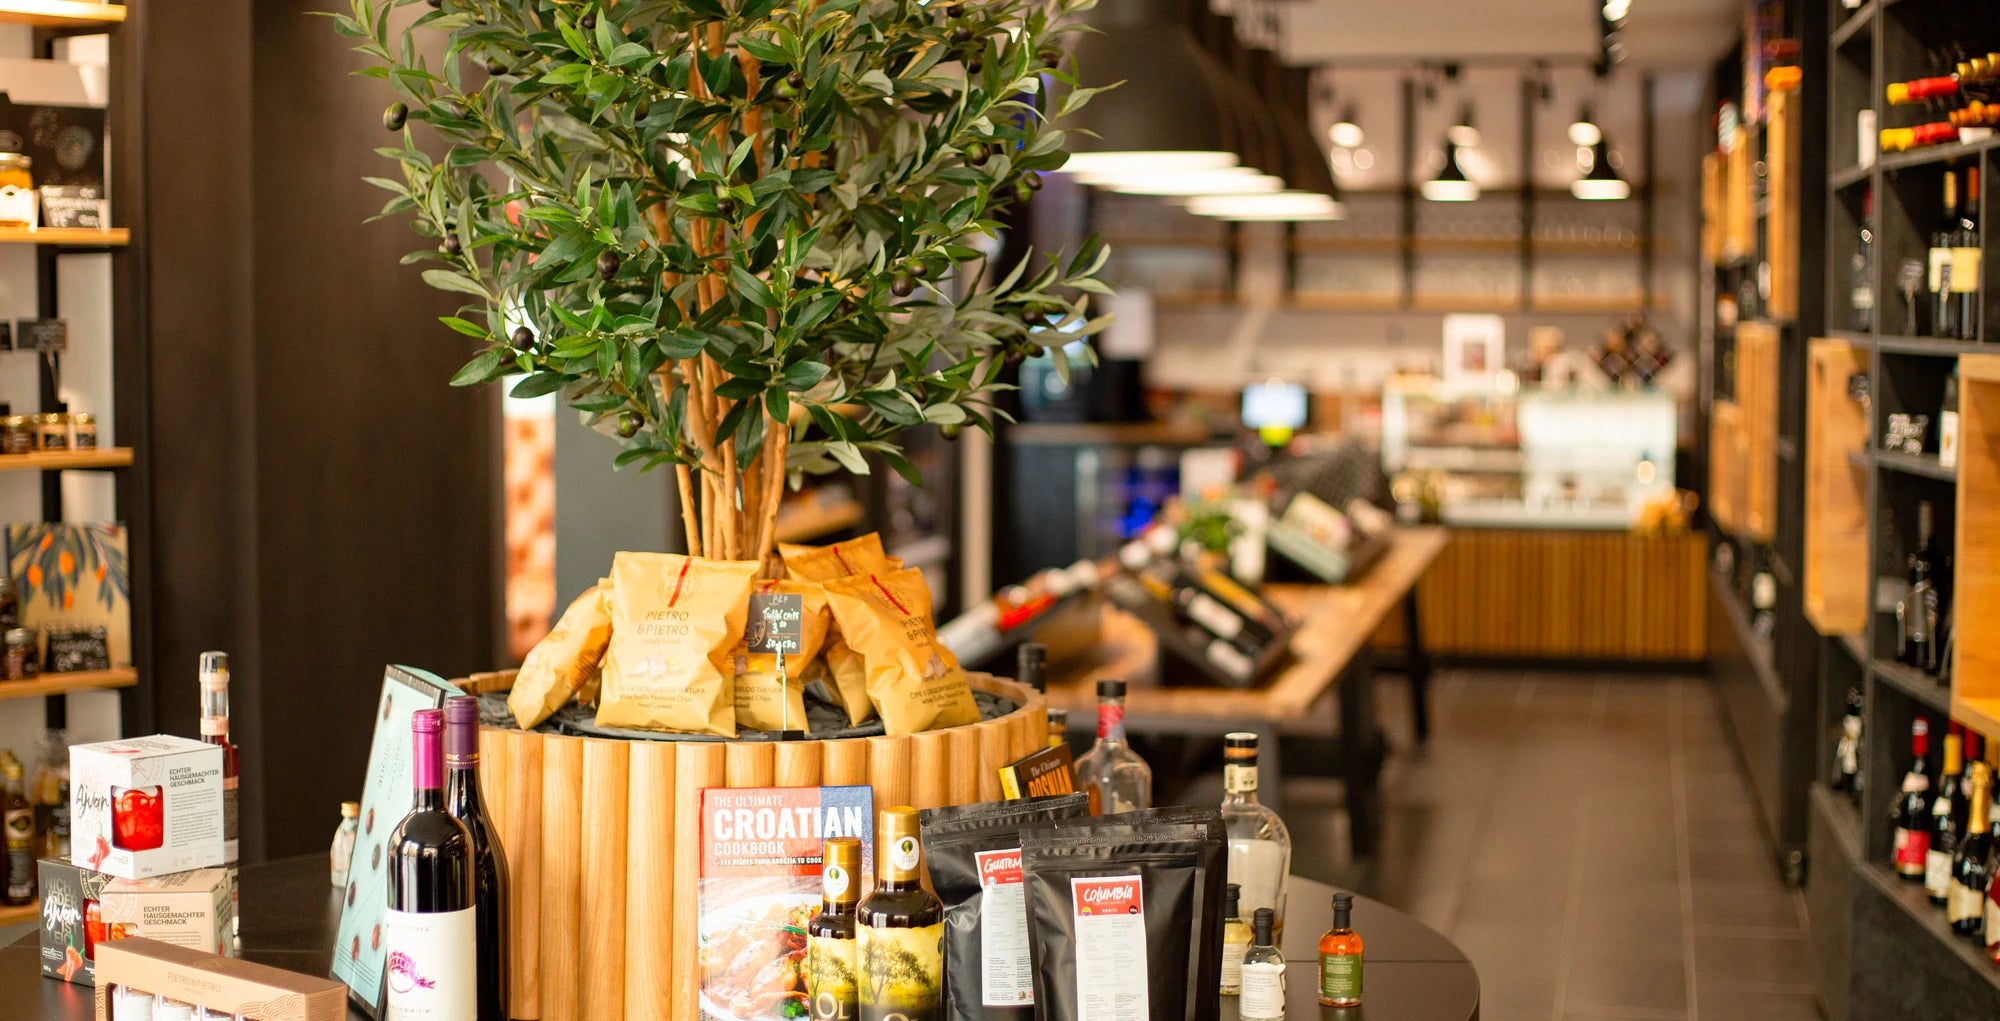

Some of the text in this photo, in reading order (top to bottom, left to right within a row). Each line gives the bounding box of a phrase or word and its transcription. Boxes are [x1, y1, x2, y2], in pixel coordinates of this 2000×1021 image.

[645, 611, 689, 621] PIETRO
[900, 616, 924, 628] PIETR
[637, 624, 689, 636] &PIETRO
[169, 767, 192, 776] ECHTER
[169, 769, 219, 781] HAUSGEMACHTER
[169, 778, 206, 788] GESCHMACK
[714, 795, 784, 807] THE ULTIMATE
[714, 806, 863, 841] CROATIAN
[714, 840, 785, 856] COOKBOOK
[771, 857, 797, 865] CROATIA
[806, 856, 822, 864] COOK
[143, 911, 205, 920] HAUSGEMACHTER
[143, 918, 187, 926] GESCHMACK
